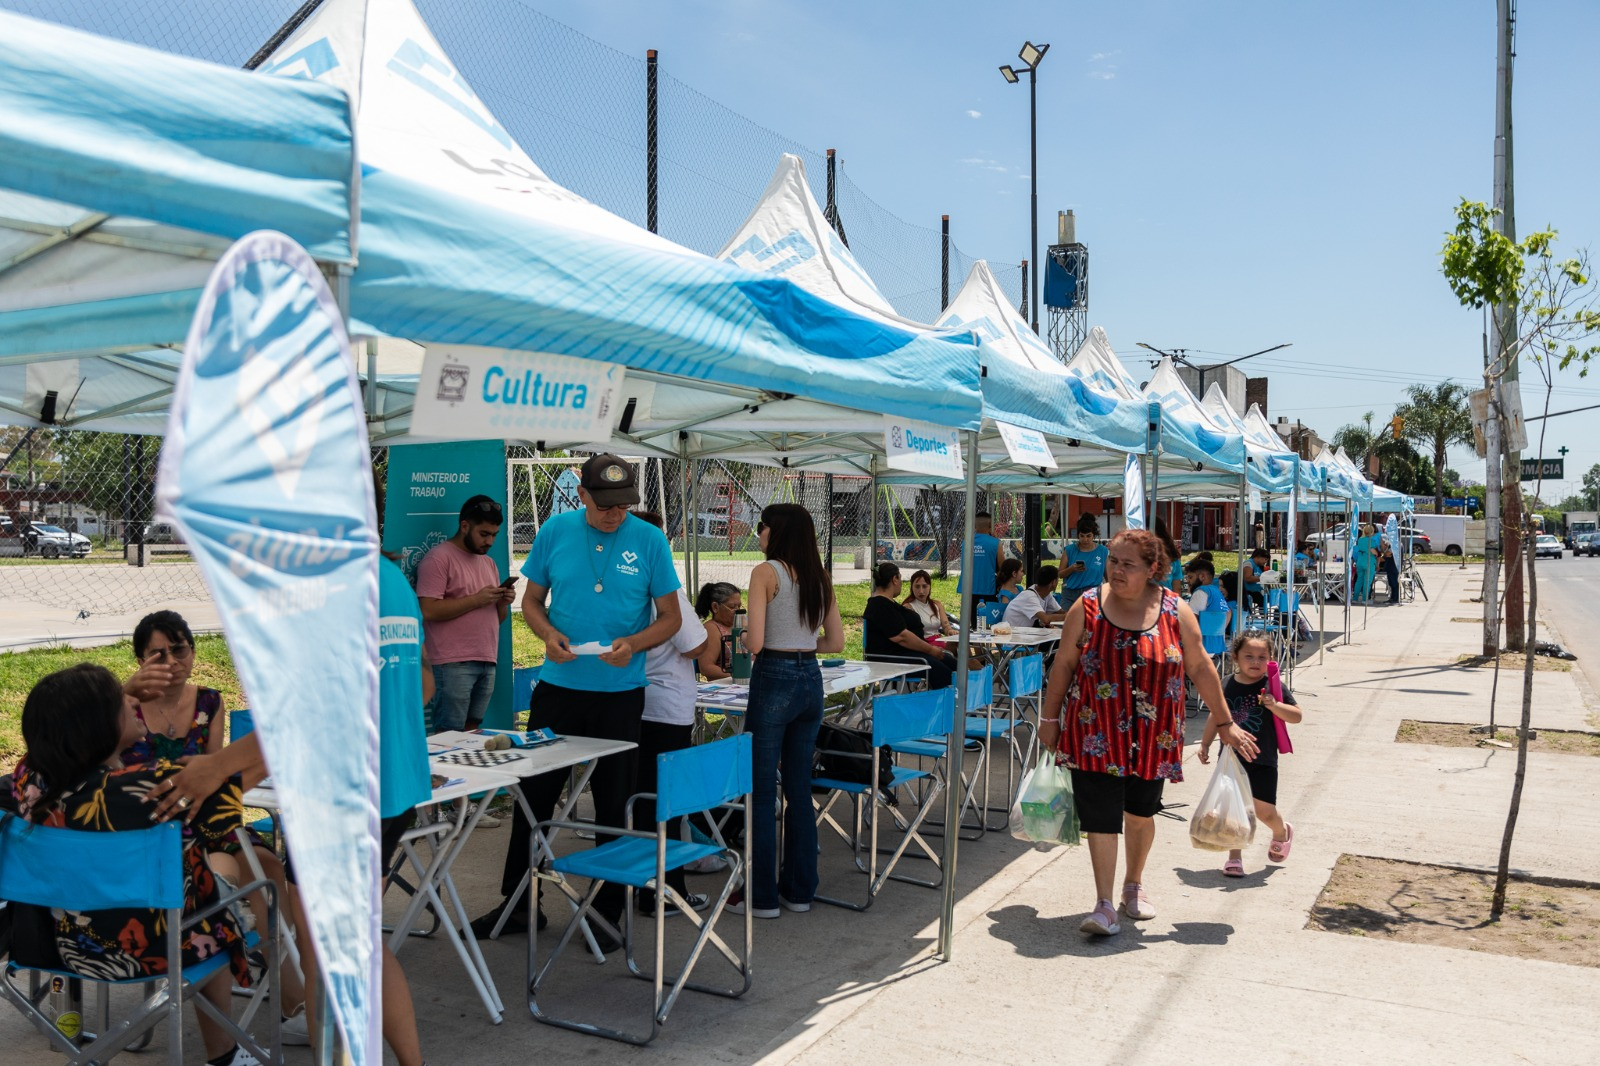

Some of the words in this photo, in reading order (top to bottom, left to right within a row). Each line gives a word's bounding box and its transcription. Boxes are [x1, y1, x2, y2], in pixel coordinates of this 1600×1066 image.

[482, 365, 588, 410] Cultura
[905, 429, 948, 456] Deportes
[411, 472, 458, 483] MINISTERIO
[459, 473, 471, 483] DE
[410, 486, 446, 499] TRABAJO
[616, 563, 639, 573] Lanús
